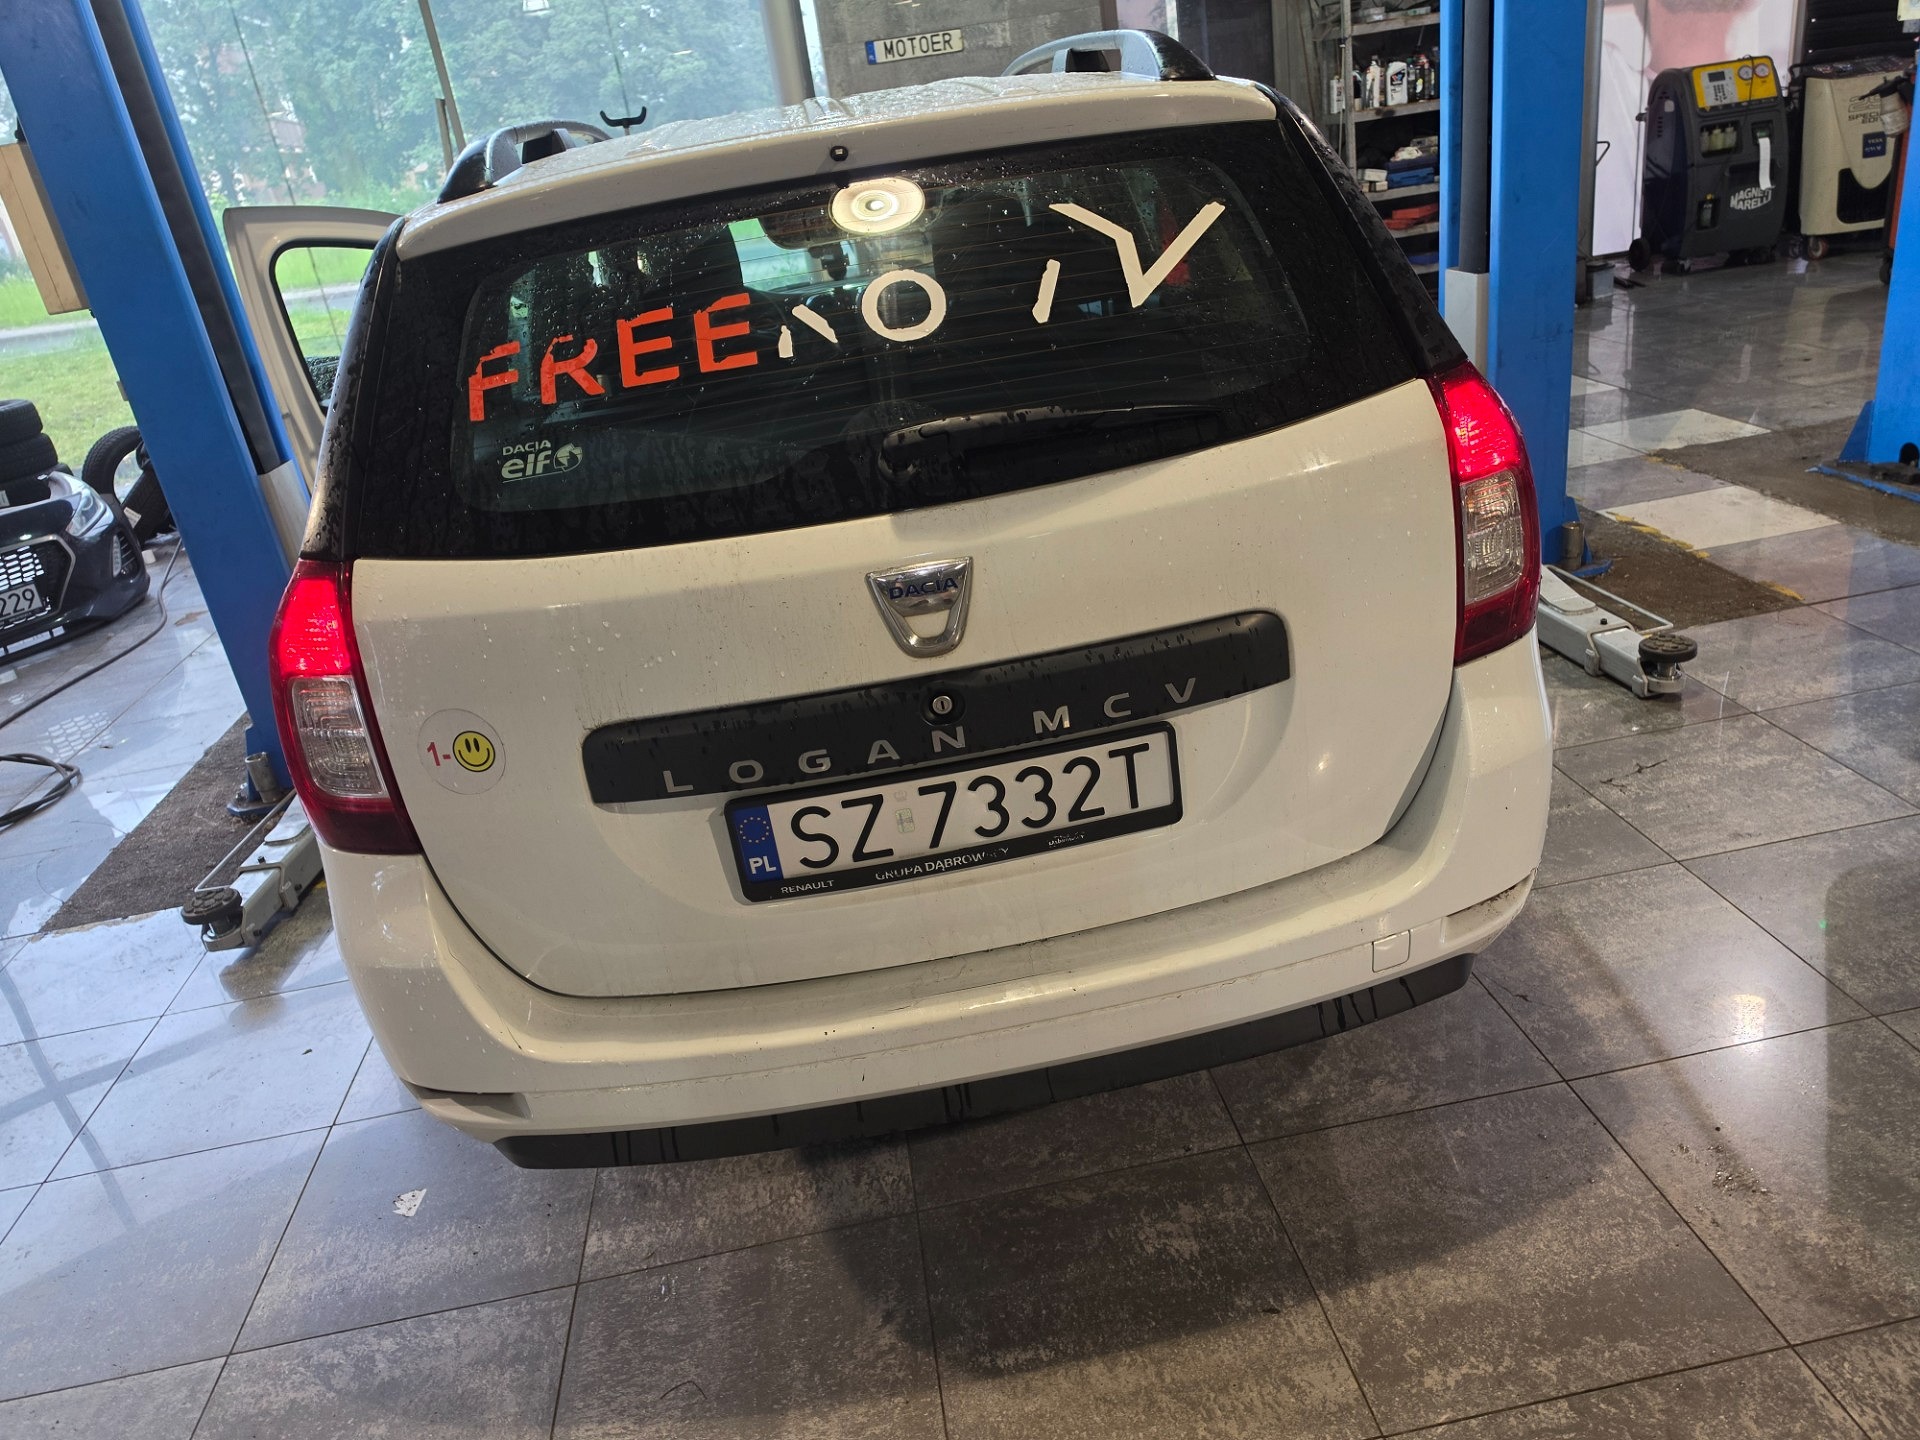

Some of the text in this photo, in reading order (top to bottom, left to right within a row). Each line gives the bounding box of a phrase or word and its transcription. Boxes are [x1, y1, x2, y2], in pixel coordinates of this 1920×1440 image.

[884, 32, 954, 59] MOTOER
[502, 439, 552, 456] DACIA
[501, 450, 552, 479] elf
[888, 577, 959, 600] DACIA
[662, 677, 1196, 793] LOGAN MCV
[790, 742, 1150, 869] SZ 7332T
[748, 855, 777, 875] PL
[780, 879, 835, 894] RENAULT
